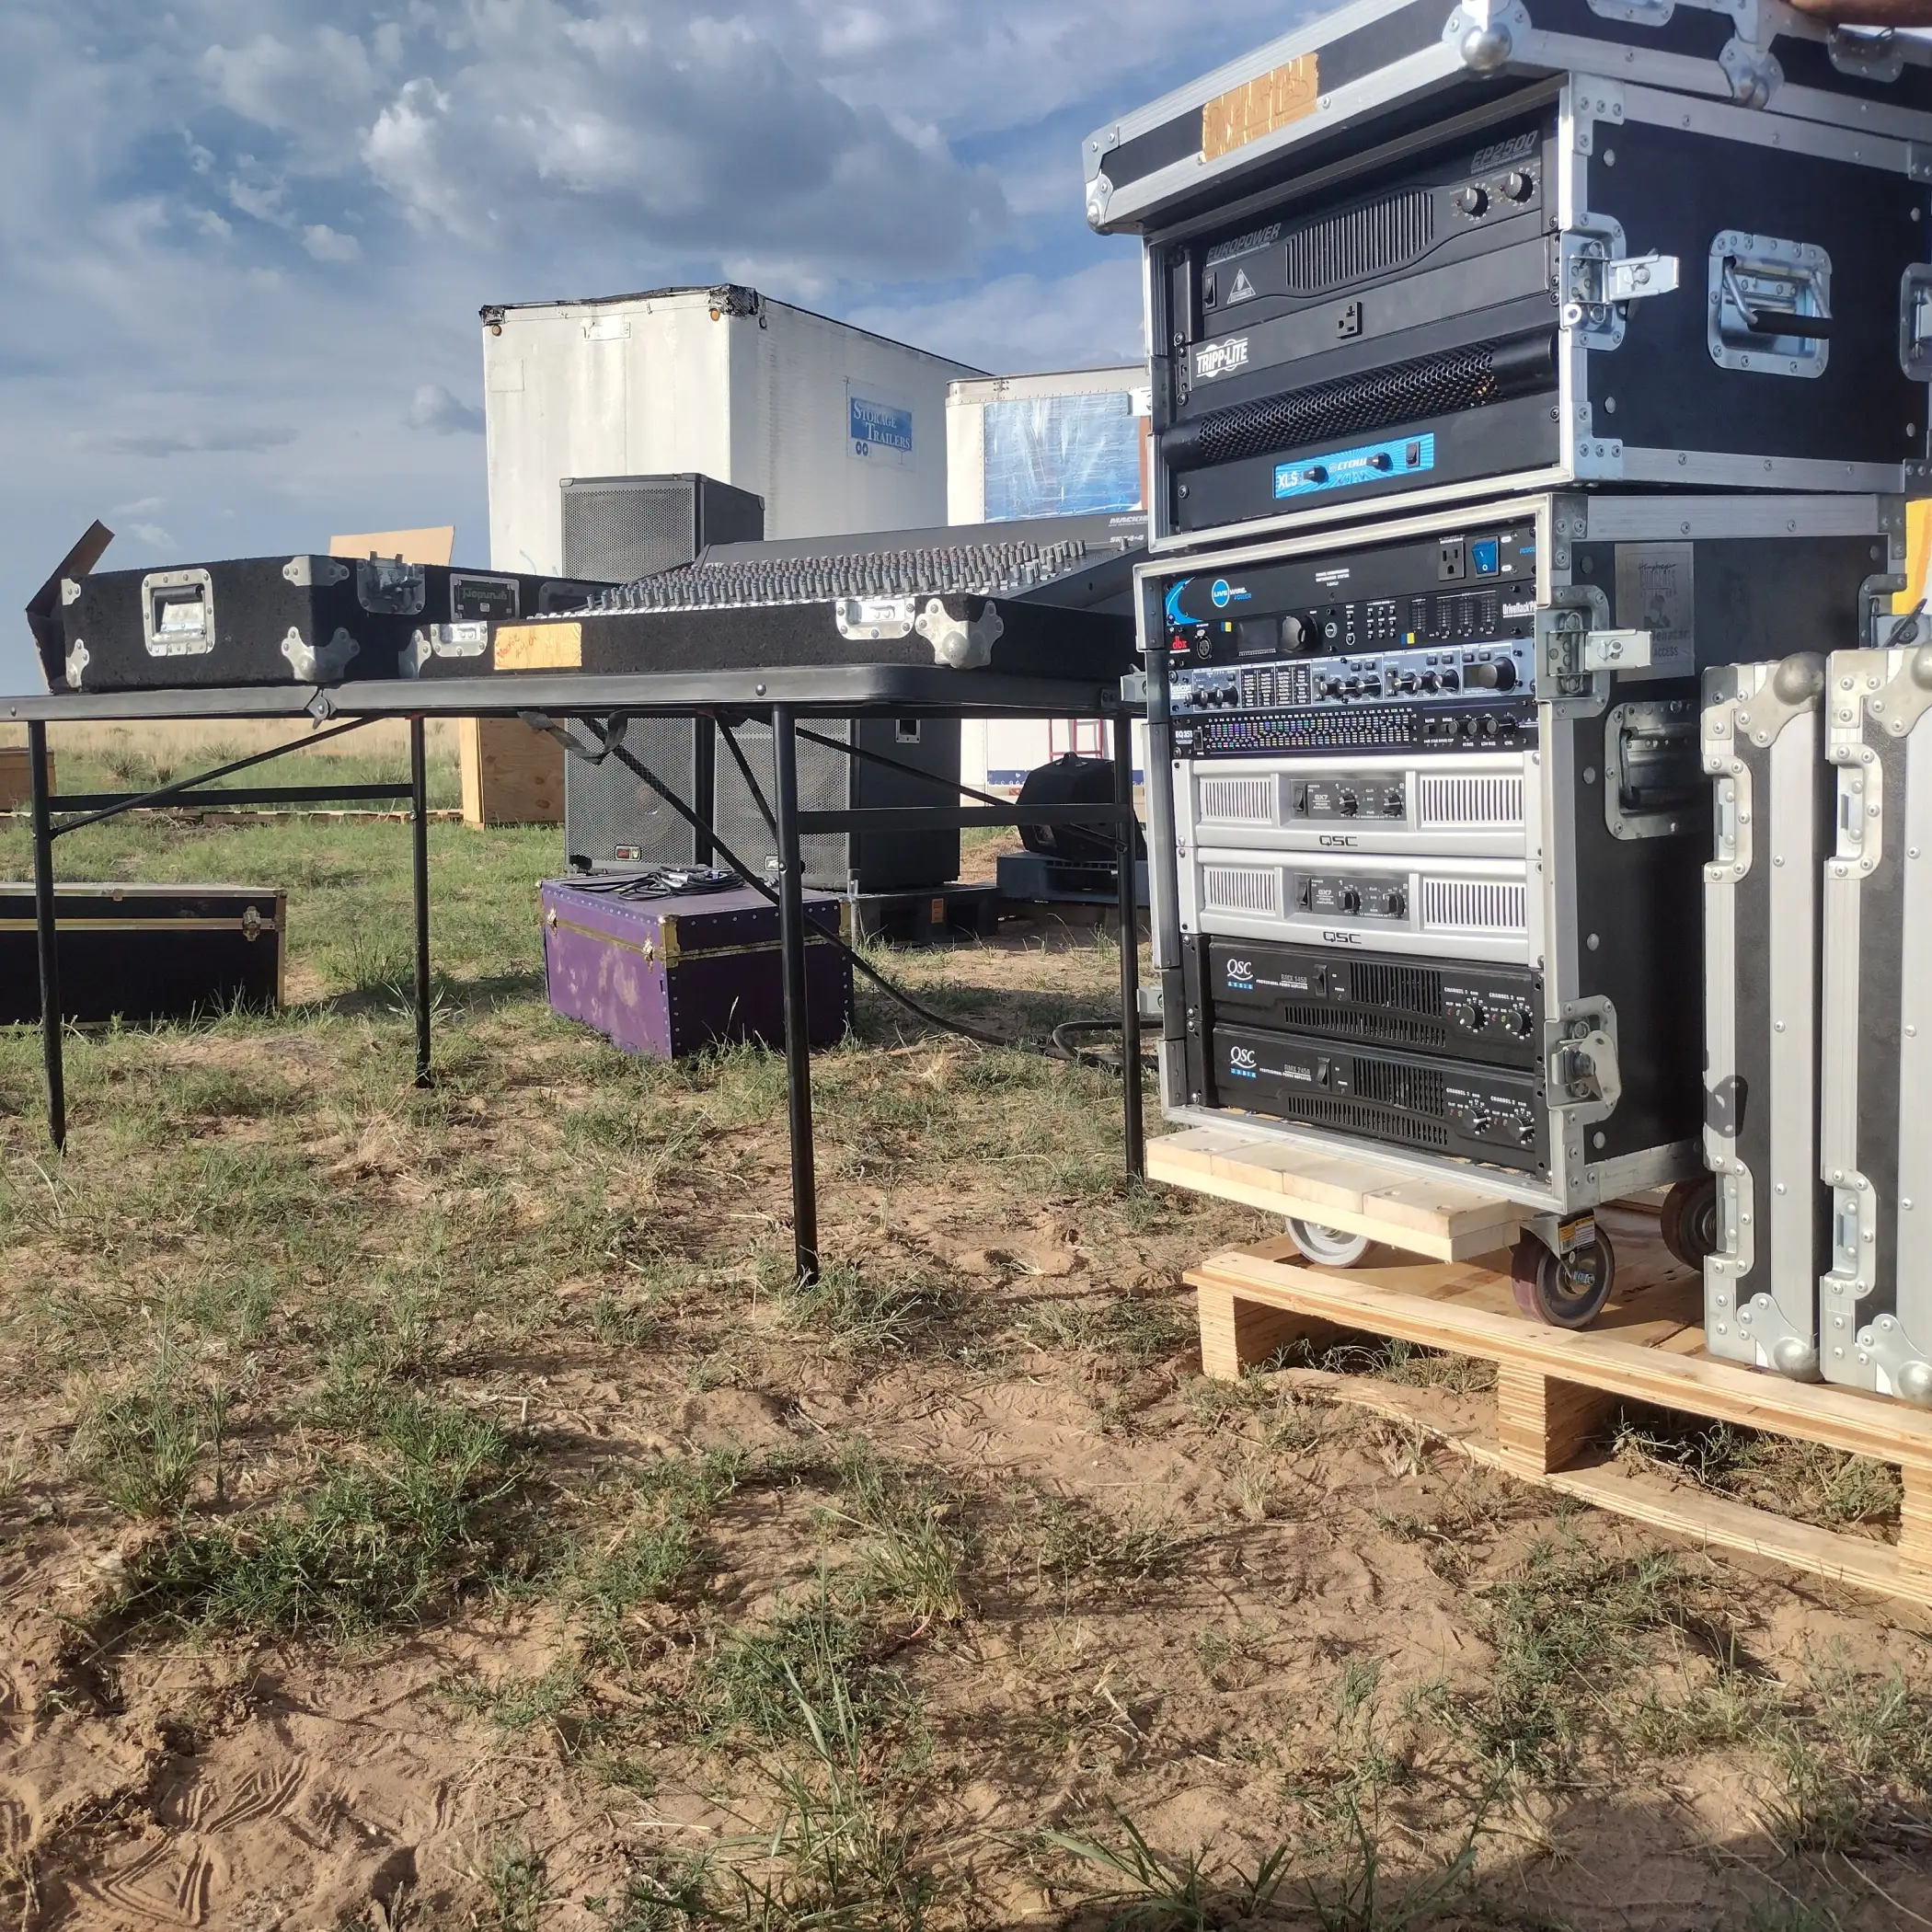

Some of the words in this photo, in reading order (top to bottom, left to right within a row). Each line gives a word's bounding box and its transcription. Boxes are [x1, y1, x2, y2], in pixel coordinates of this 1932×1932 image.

[1471, 131, 1538, 169] EP2500
[1206, 223, 1282, 263] EUROPOWER
[854, 400, 897, 429] STORAGE
[866, 421, 911, 449] TRAILERS
[1278, 470, 1298, 489] XLS
[1172, 636, 1187, 650] dbx
[1170, 683, 1191, 693] lexicon
[1175, 730, 1193, 739] EQ351
[1319, 834, 1358, 846] QSC
[1323, 931, 1362, 944] QSC
[1227, 959, 1253, 981] QSC
[1294, 975, 1307, 983] 1450
[1231, 1046, 1257, 1068] QSC
[1297, 1066, 1310, 1075] 2450
[1446, 1087, 1466, 1096] CHANNEL
[1490, 1096, 1512, 1104] CHANNEL
